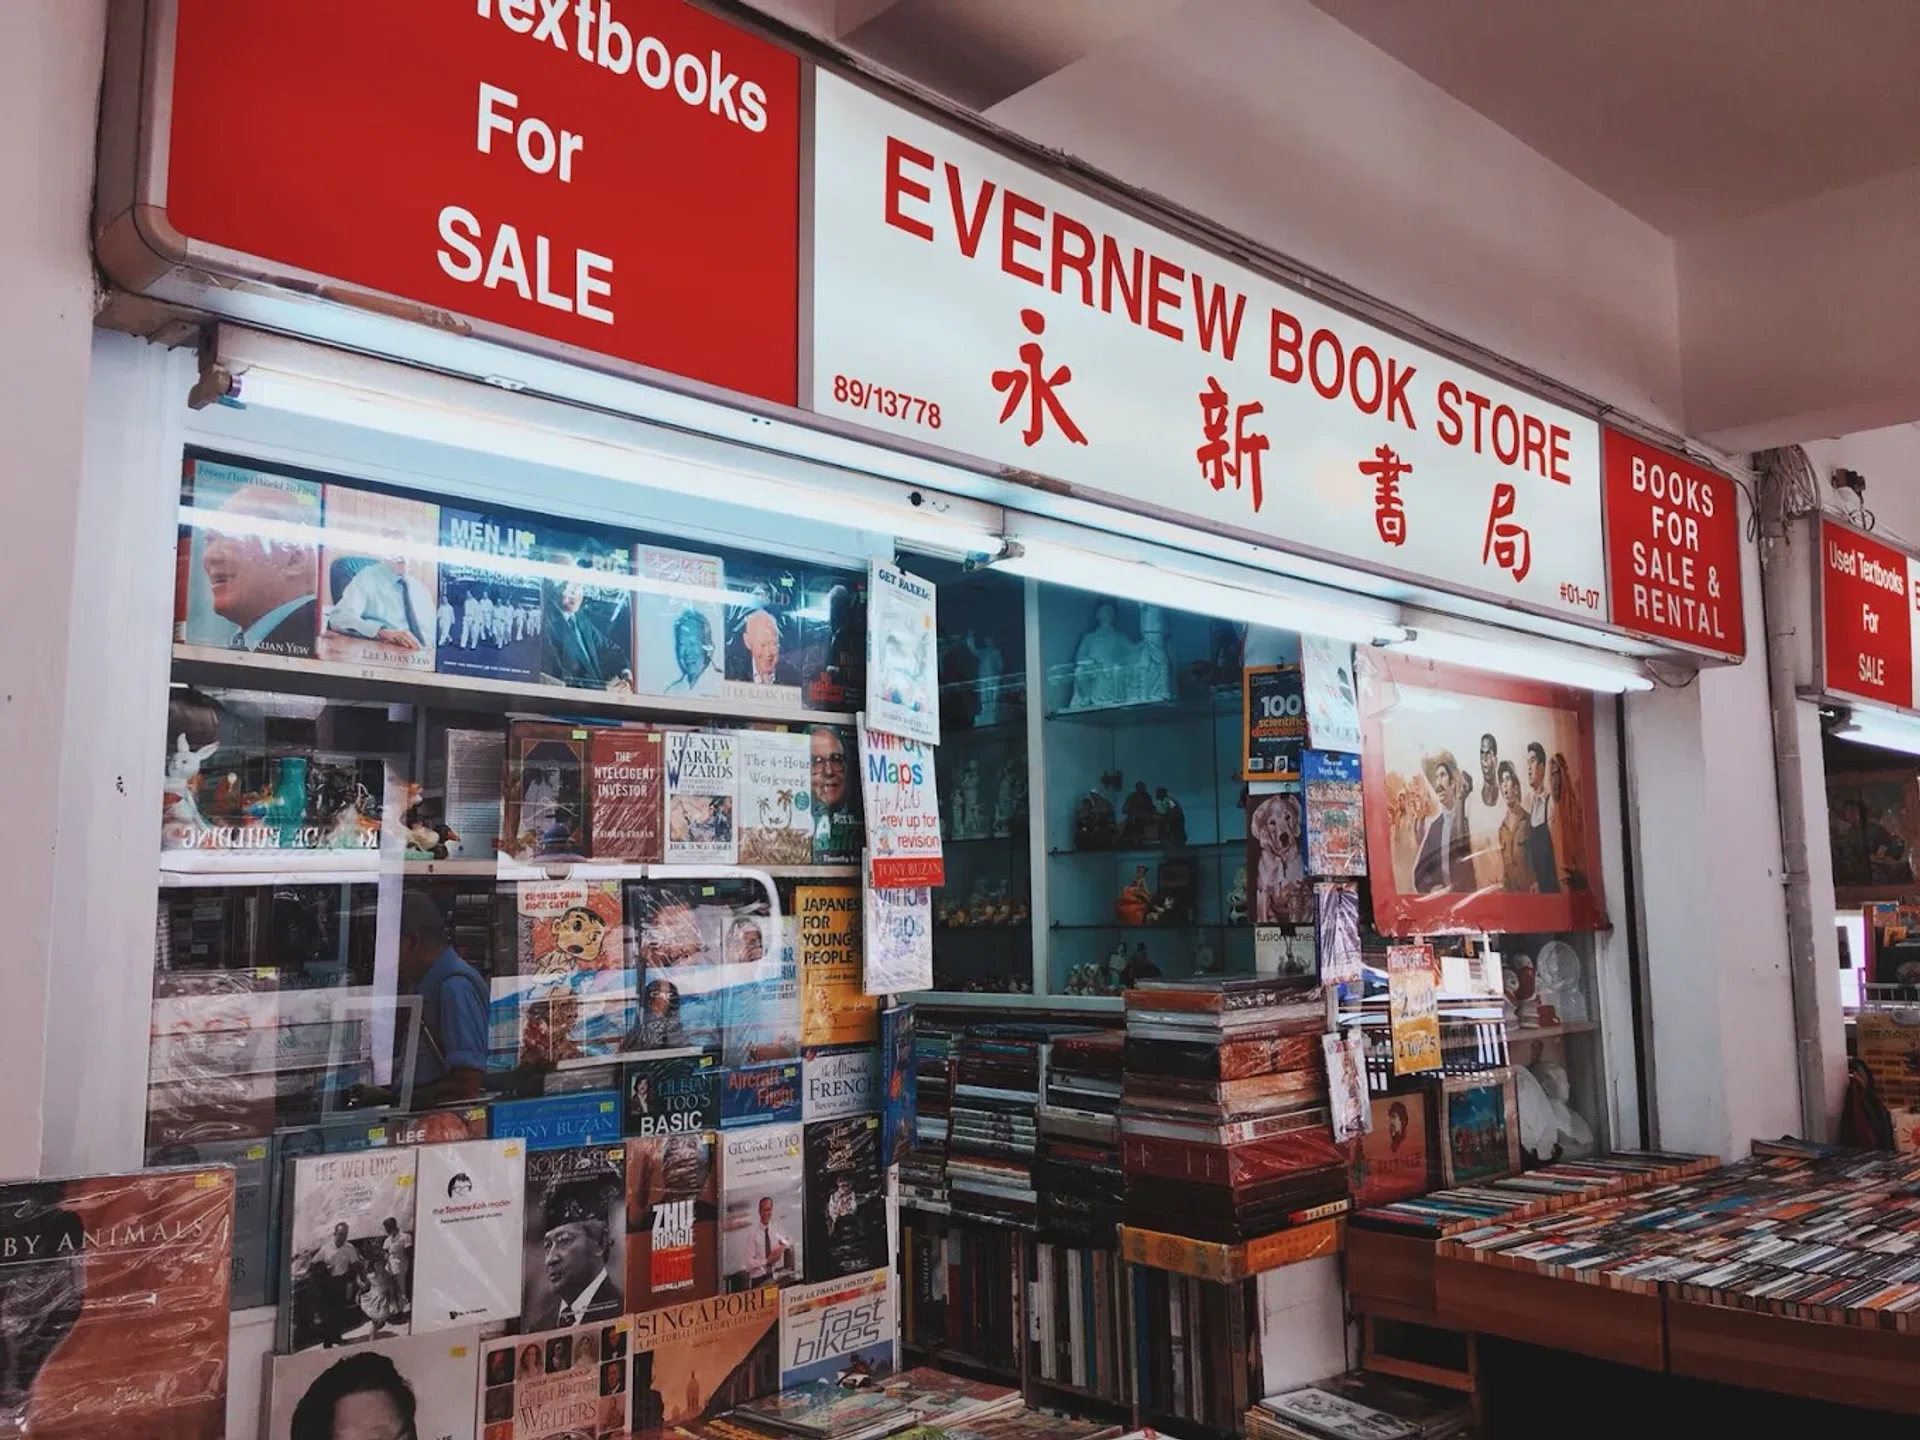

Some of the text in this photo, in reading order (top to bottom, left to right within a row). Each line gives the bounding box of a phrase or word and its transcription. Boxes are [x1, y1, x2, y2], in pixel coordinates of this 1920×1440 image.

[476, 0, 768, 133] extbooks
[476, 81, 584, 183] For
[436, 206, 614, 325] SALE
[884, 135, 1572, 485] EVERNEW BOOK STORE
[833, 374, 942, 430] 89/13778
[991, 308, 1532, 584] 永新書局
[1632, 456, 1714, 518] BOOKS
[451, 517, 500, 545] MEN
[1652, 505, 1699, 552] FOR
[1632, 541, 1720, 599] SALE &
[1829, 540, 1856, 577] Used
[1857, 551, 1904, 596] Textbooks
[1559, 581, 1601, 611] #01-07
[1633, 583, 1725, 640] RENTAL
[1863, 604, 1879, 634] For
[286, 641, 310, 656] YEW
[362, 648, 382, 662] LEE
[411, 654, 431, 667] YEW
[1859, 653, 1884, 686] SALE
[1261, 694, 1302, 717] 100
[615, 751, 631, 762] THE
[669, 736, 731, 750] THE NEW
[594, 766, 656, 780] NTELLIGENT
[744, 753, 811, 770] The 4-Hour
[868, 754, 923, 789] Maps
[667, 763, 733, 788] WIZARDS
[749, 772, 806, 787] Workweek
[598, 783, 648, 798] INVESTOR
[906, 815, 920, 831] up
[922, 812, 937, 828] for
[897, 834, 940, 849] revision
[877, 861, 941, 877] TONY BUZAN
[803, 897, 862, 912] JAPANES
[803, 915, 829, 929] FOR
[803, 933, 851, 947] YOUNG
[804, 949, 854, 965] PEOPLE
[729, 1066, 780, 1091] Aircraft
[664, 1092, 711, 1111] TOO'S
[756, 1084, 795, 1111] Flight
[395, 1130, 426, 1144] LEE
[557, 1116, 614, 1136] BUZAN
[640, 1110, 703, 1138] BASIC
[728, 1133, 799, 1155] GEORGE YEO
[341, 1160, 365, 1179] WEI
[445, 1204, 471, 1215] Tommy
[472, 1201, 486, 1210] Koh
[652, 1199, 696, 1231] ZHU
[3, 1219, 204, 1257] BY ANIMALS
[790, 1276, 875, 1303] THE ULTIMATE HISTORY
[820, 1297, 887, 1337] fast
[646, 1330, 692, 1348] PICTORIAL
[694, 1320, 731, 1336] HISTORY
[793, 1321, 881, 1366] bikes
[519, 1378, 598, 1408] GREAT BRITISH
[518, 1400, 597, 1435] WRITERS
